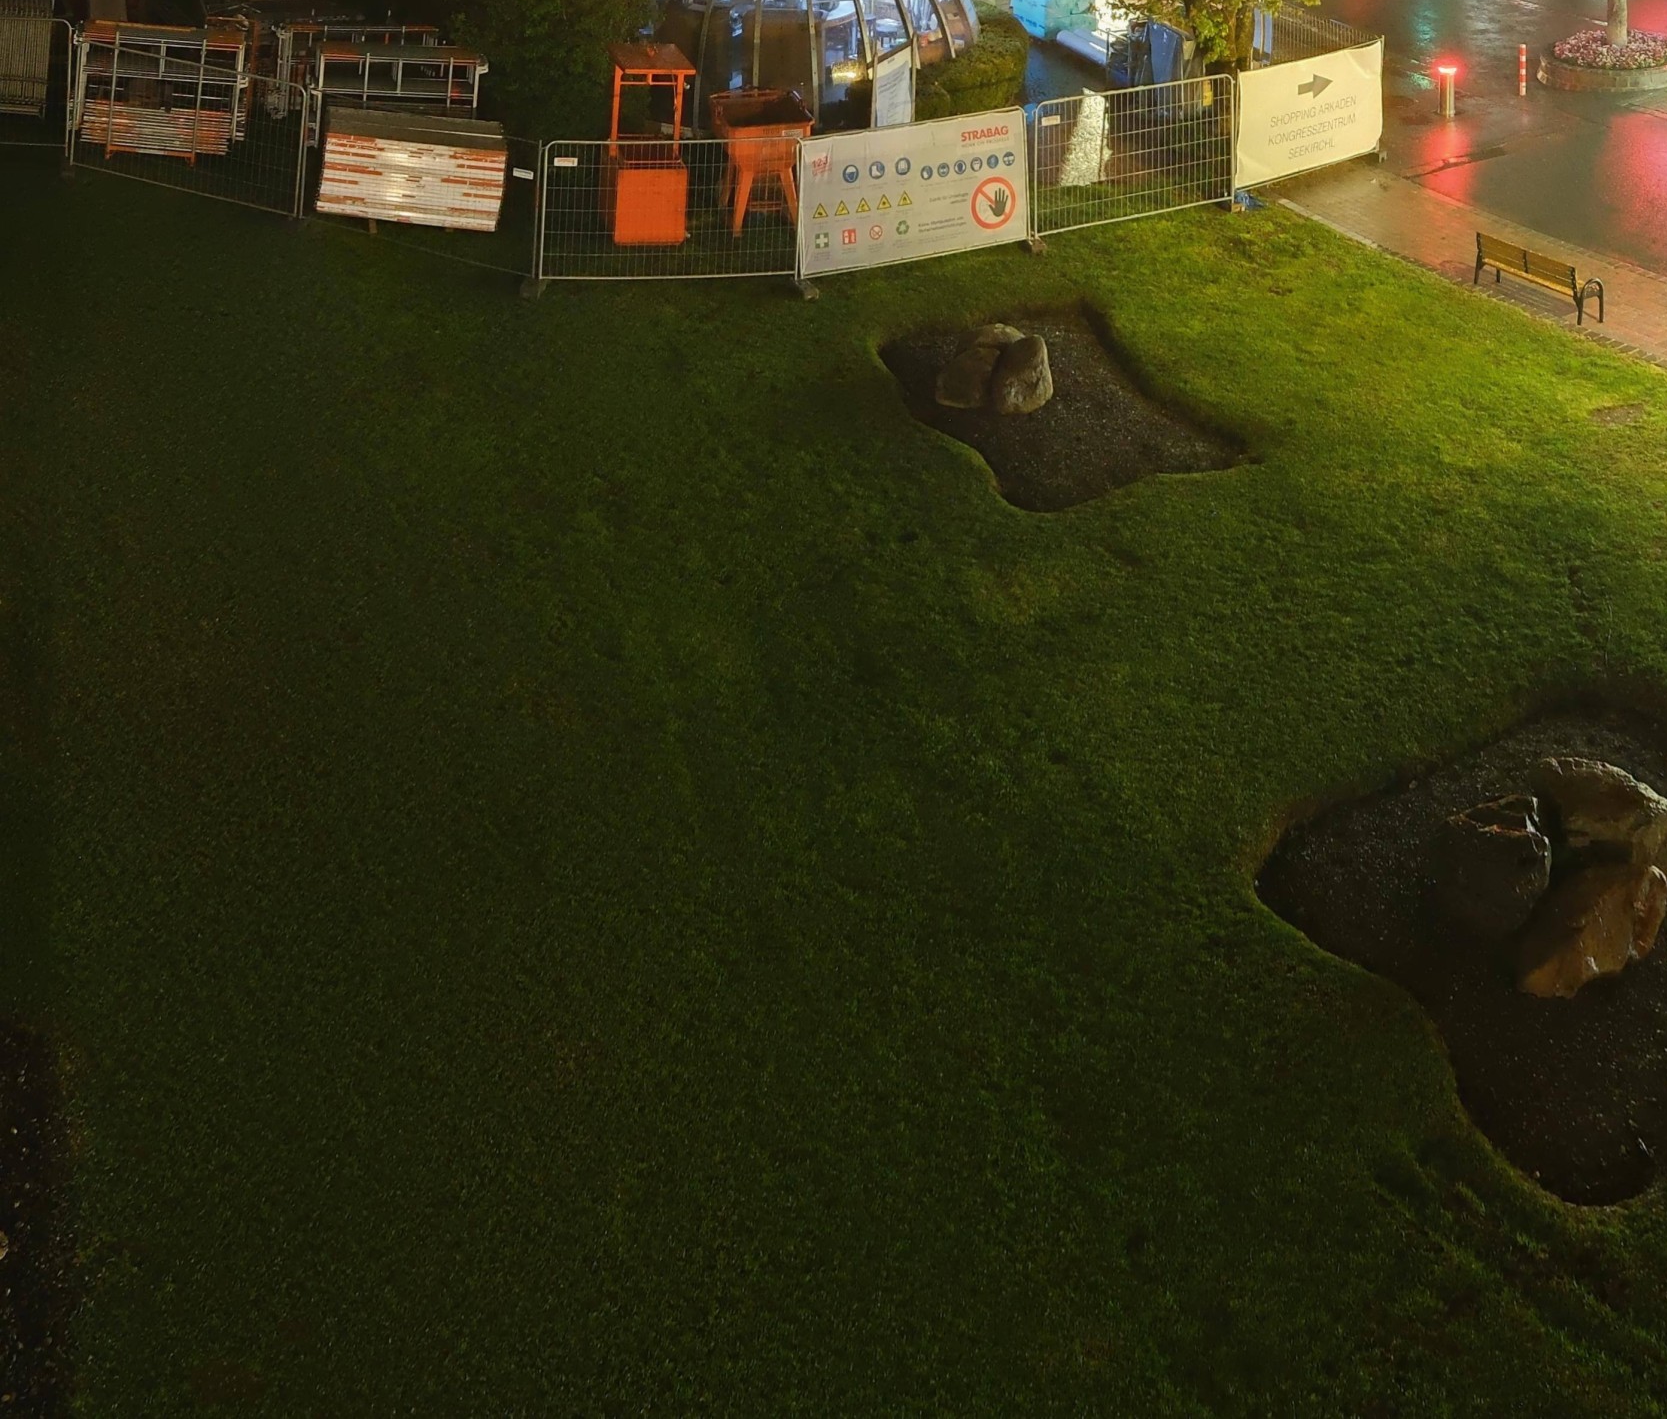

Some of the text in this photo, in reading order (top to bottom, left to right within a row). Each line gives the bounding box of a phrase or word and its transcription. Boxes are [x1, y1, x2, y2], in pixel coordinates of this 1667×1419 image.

[1270, 95, 1358, 128] SHOPPING ARKADEN
[961, 125, 1009, 142] STRABAG
[1267, 112, 1357, 147] KONGRESSZENTRUM
[1287, 138, 1336, 160] SEEKIRCHL
